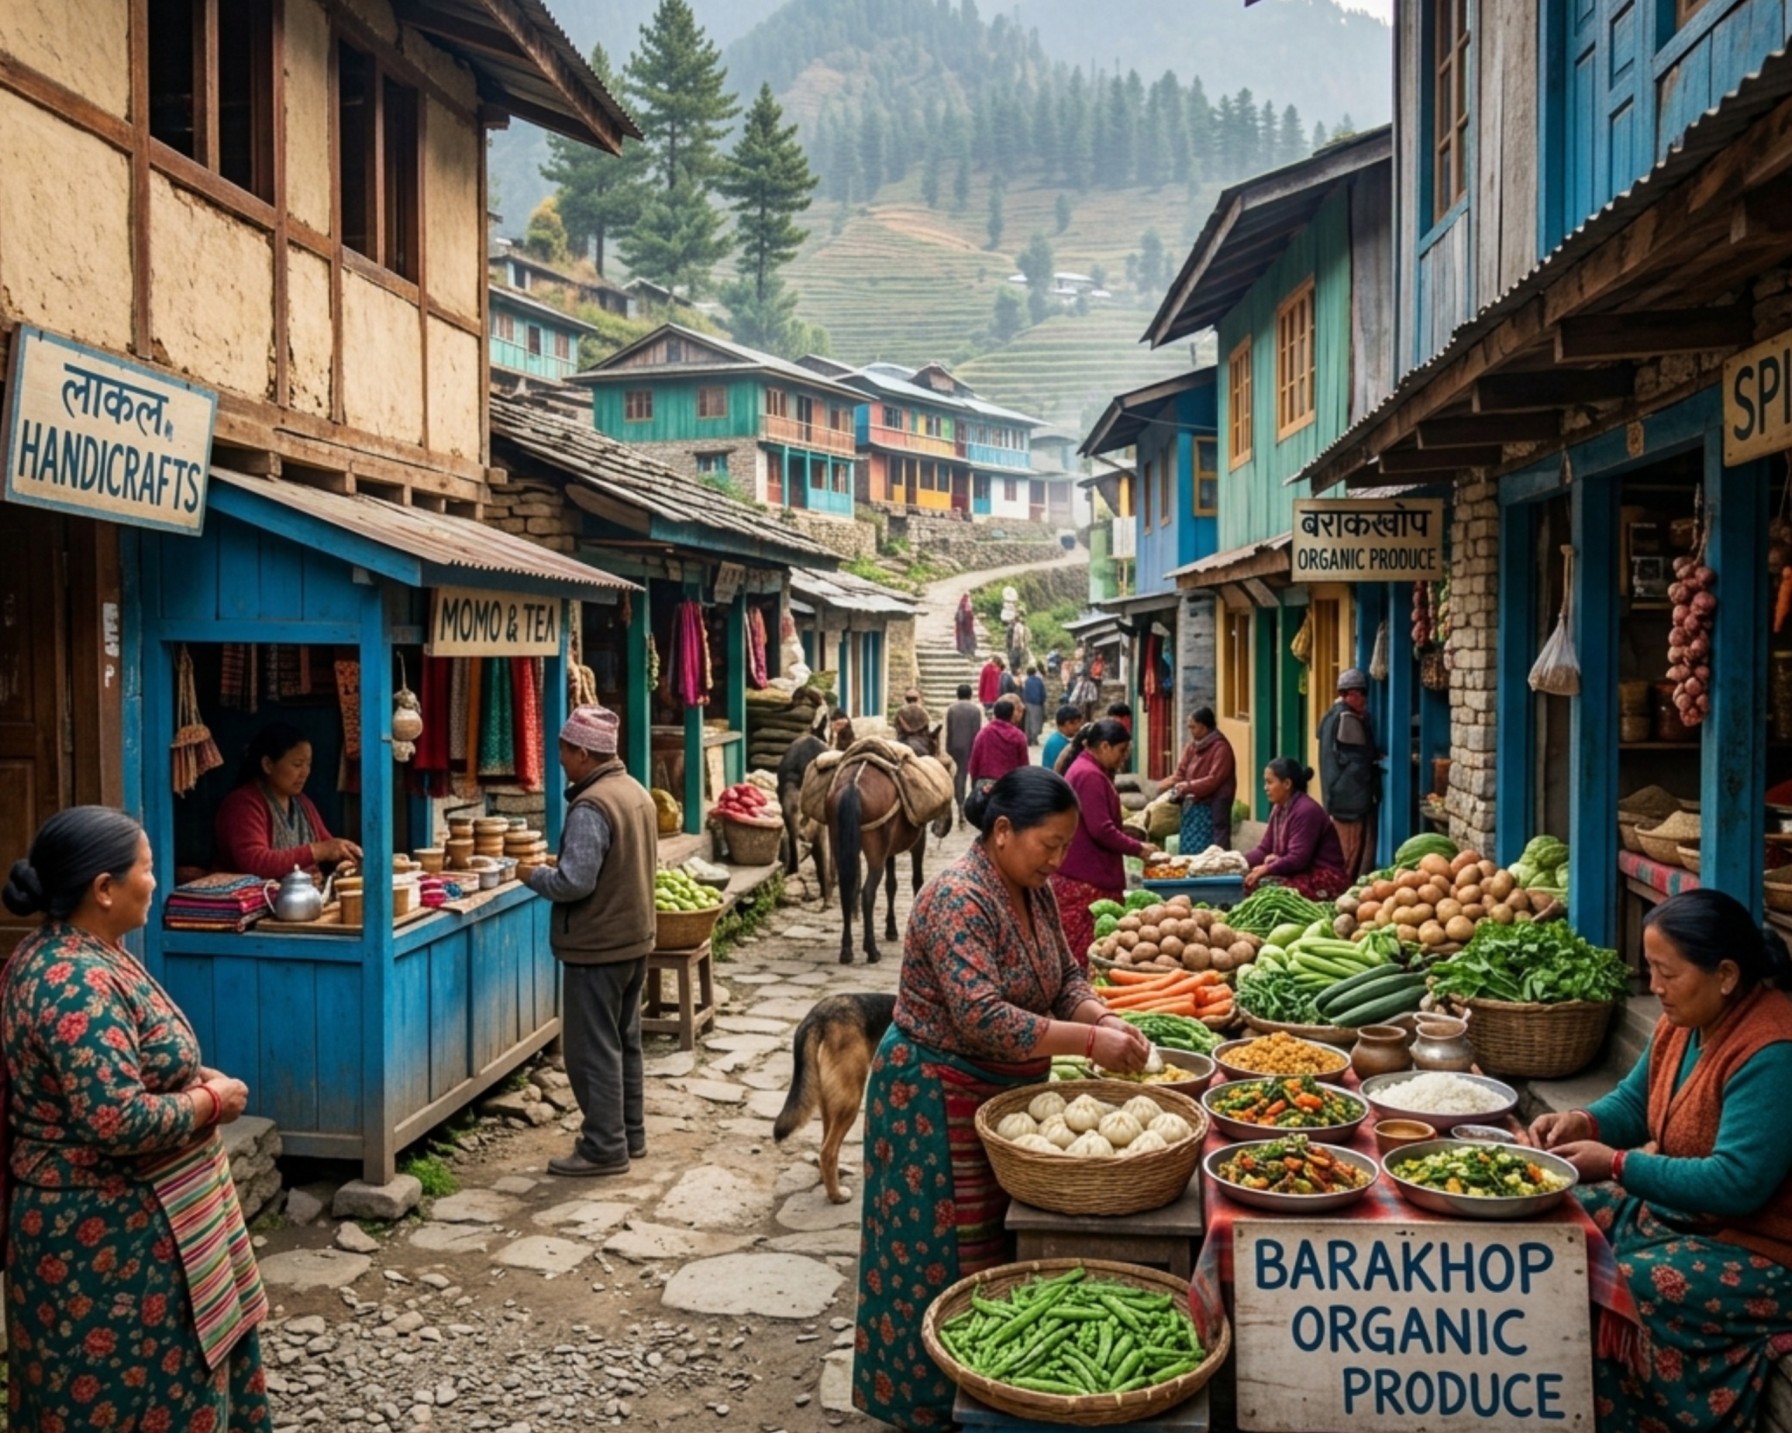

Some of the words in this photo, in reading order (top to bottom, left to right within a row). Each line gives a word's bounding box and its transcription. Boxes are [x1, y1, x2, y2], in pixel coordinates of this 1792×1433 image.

[18, 419, 201, 513] HANDICRAFTS
[1298, 548, 1365, 570] ORGANIC
[1369, 548, 1436, 570] PRODUCE
[440, 597, 502, 643] MOMO
[506, 603, 518, 643] &
[524, 603, 555, 643] TEA
[1255, 1239, 1554, 1294] BARAKHOP
[1292, 1305, 1527, 1356] ORGANIC
[1343, 1368, 1565, 1420] PRODUCE
